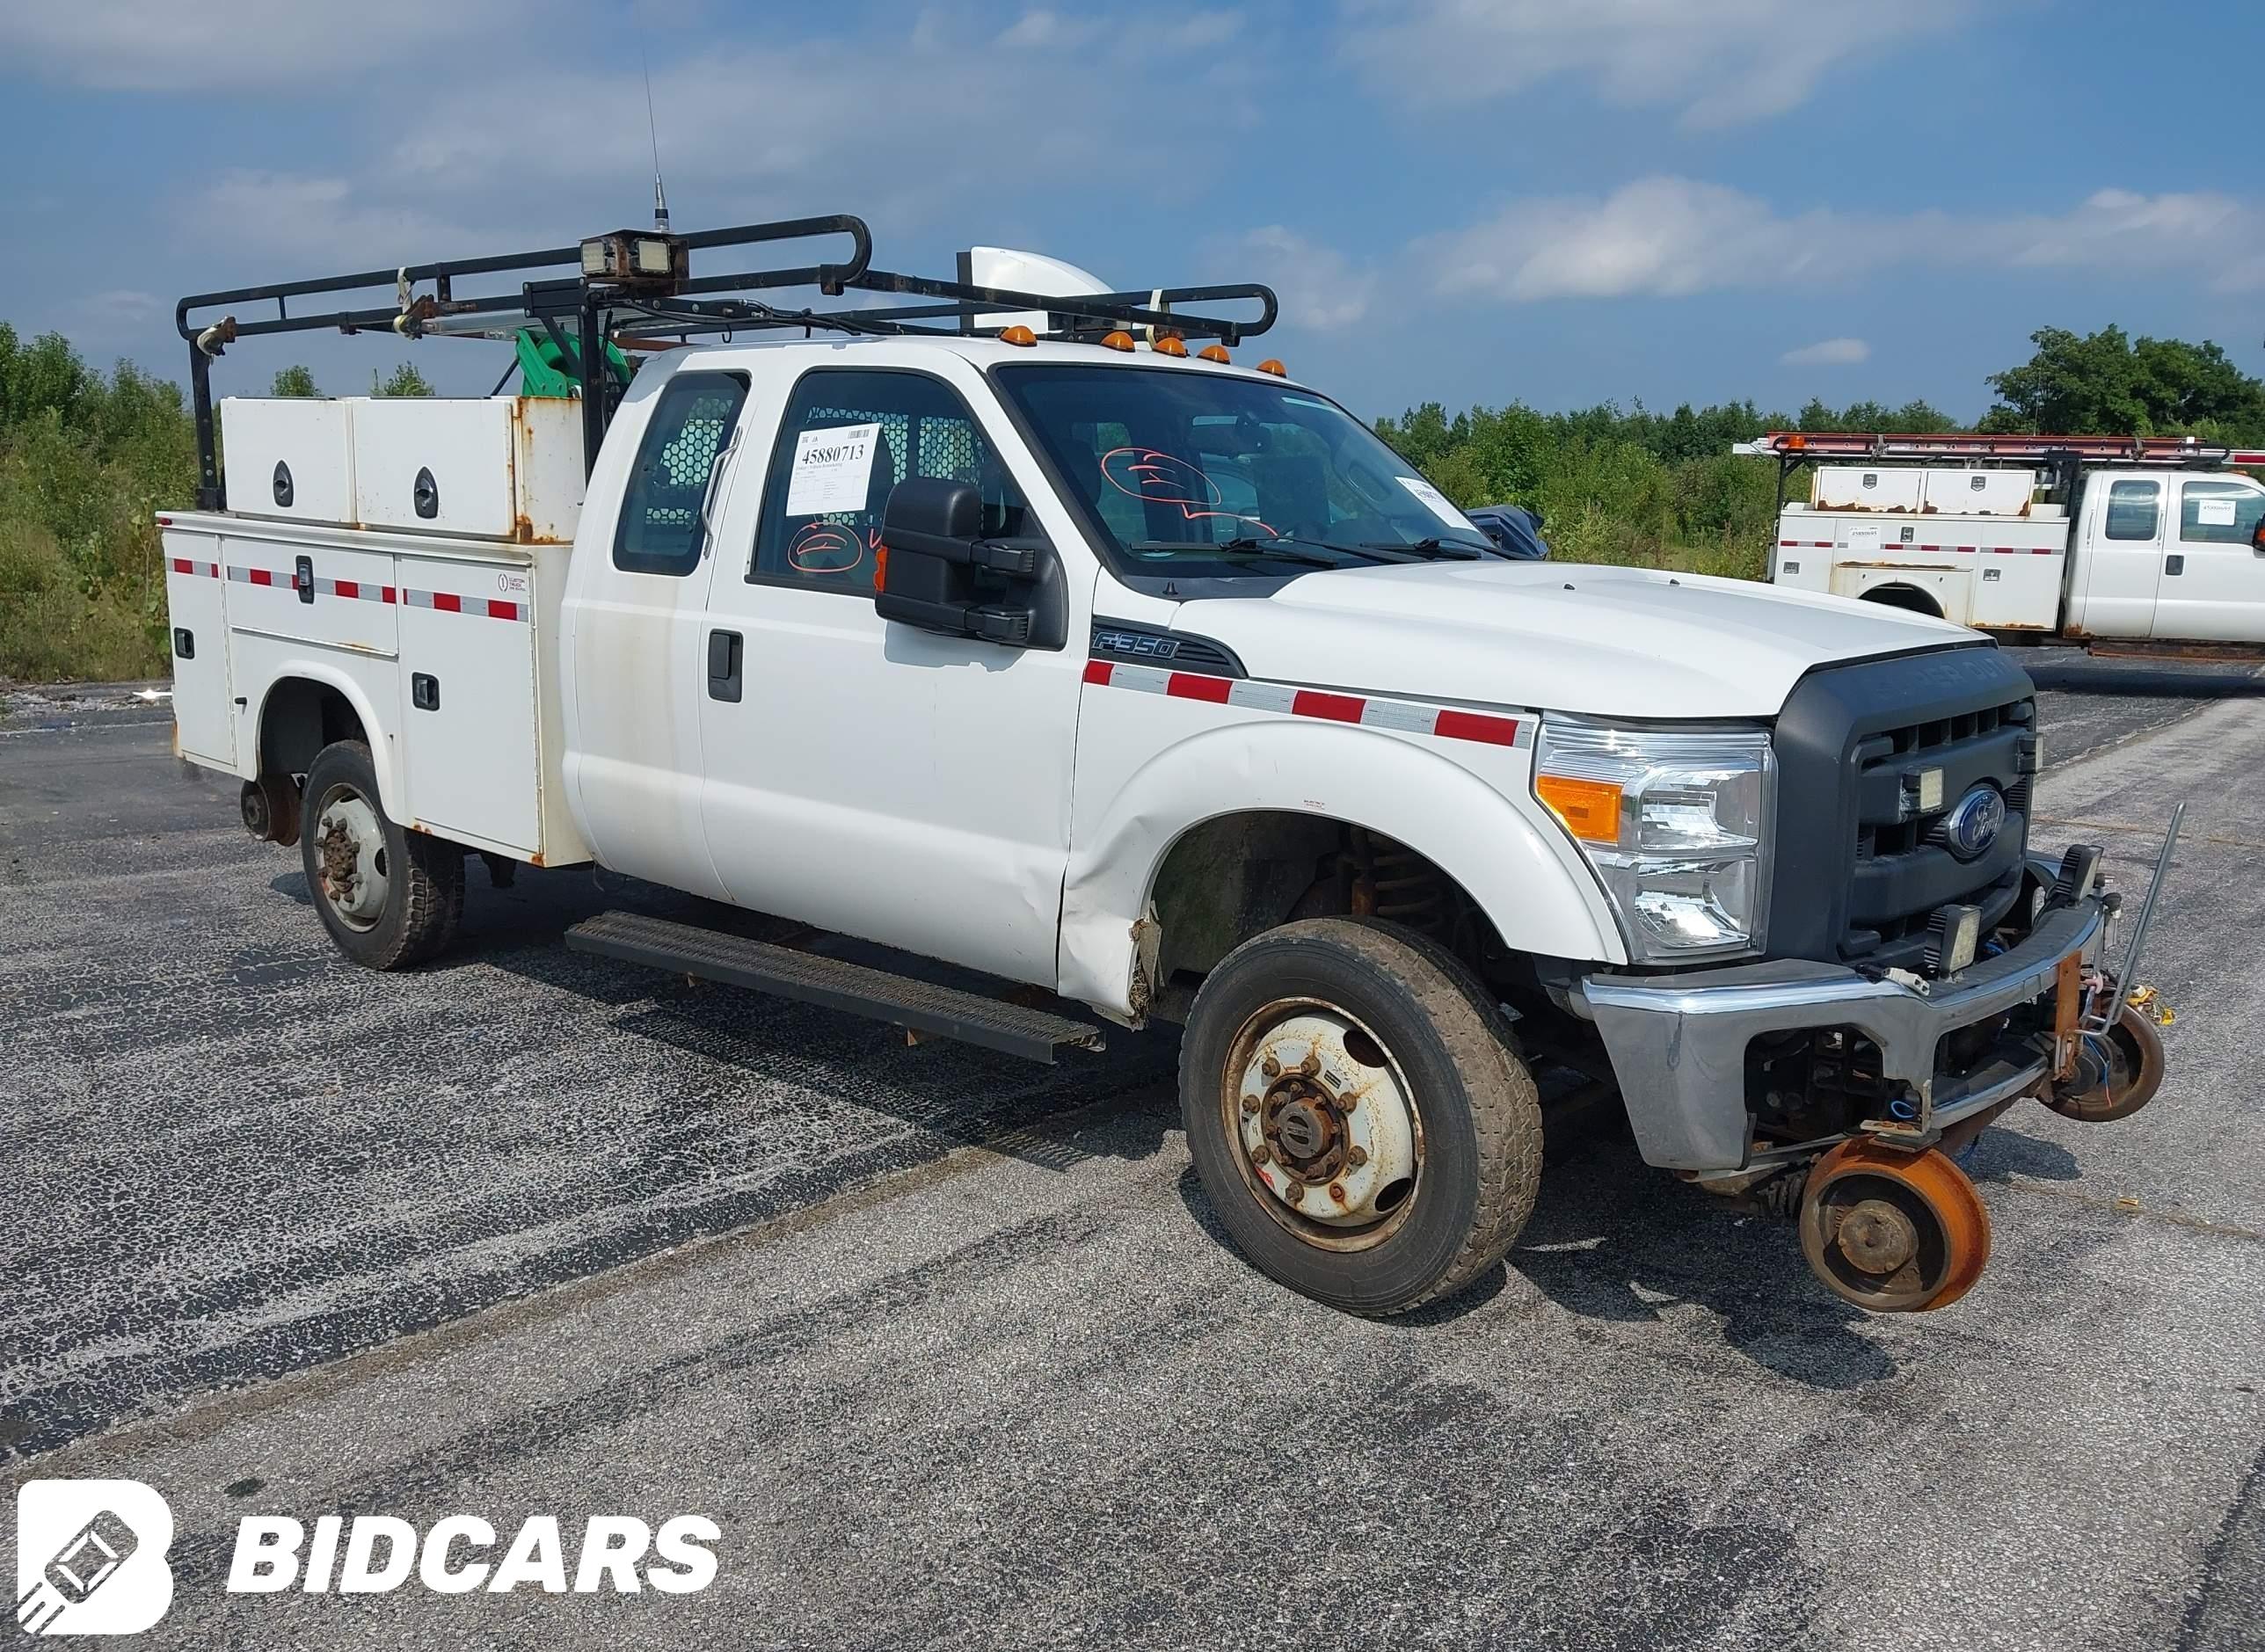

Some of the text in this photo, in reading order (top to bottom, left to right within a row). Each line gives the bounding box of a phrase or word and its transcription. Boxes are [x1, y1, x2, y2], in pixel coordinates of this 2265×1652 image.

[802, 444, 864, 465] 45880713
[1092, 631, 1180, 659] F-350
[1972, 801, 2000, 841] Ford
